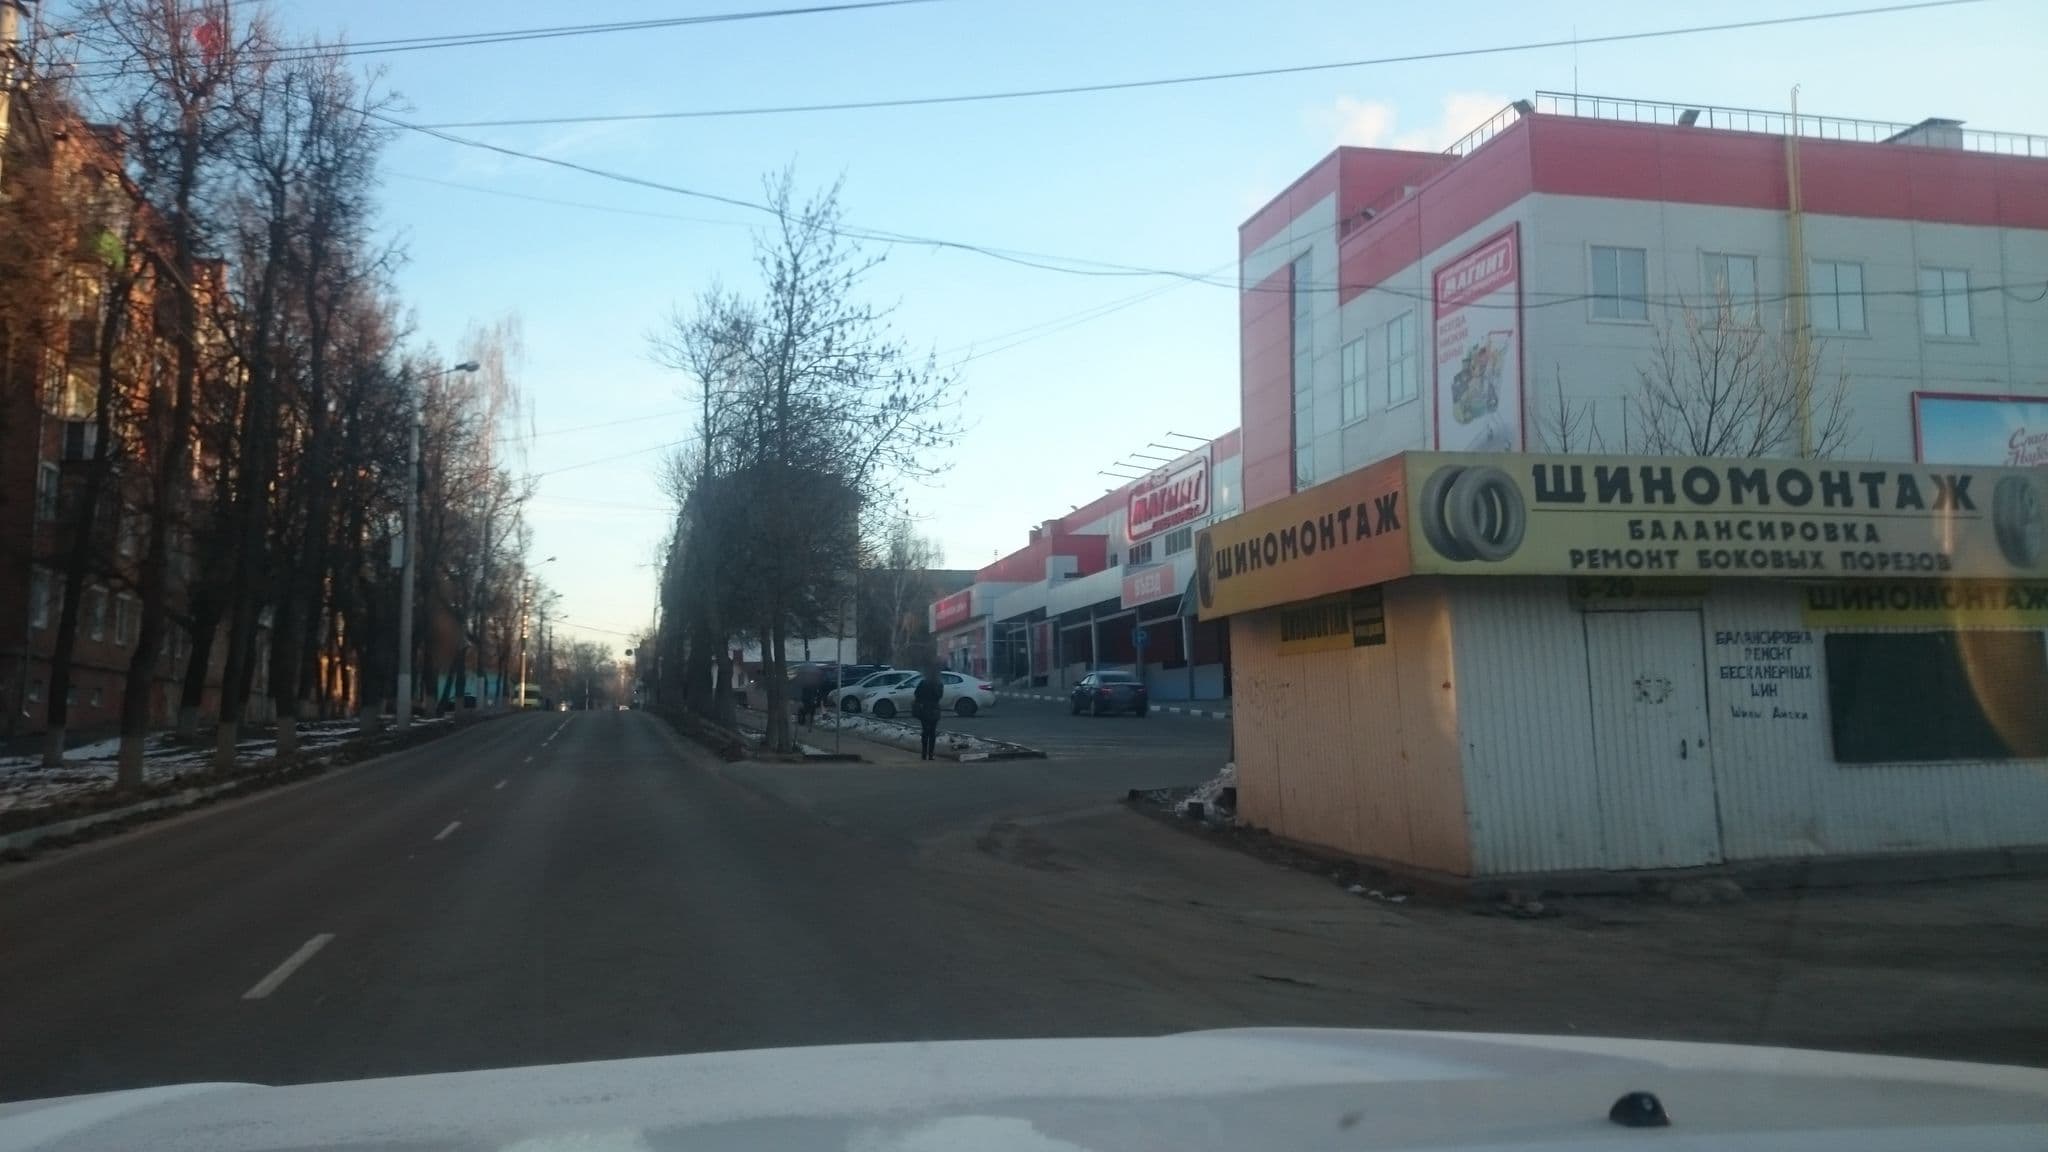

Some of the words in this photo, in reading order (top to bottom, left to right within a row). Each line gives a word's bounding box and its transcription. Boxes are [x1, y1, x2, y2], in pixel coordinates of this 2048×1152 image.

[1443, 248, 1507, 299] МАГНИТ
[1531, 464, 1977, 511] ШИНОМОНТАЖ
[1215, 491, 1401, 580] ШИНОМОНТАЖ
[1628, 519, 1881, 543] БАЛАНСИРОВКА
[1569, 549, 1679, 570] РЕМОНТ
[1697, 549, 1824, 571] БОКОВЫХ
[1841, 551, 1952, 572] ПОРЕЗОВ
[1807, 582, 2048, 611] ШИНОМОНТАЖ
[1715, 631, 1814, 645] БАЛАНСИРОВКА
[1744, 647, 1793, 661] РЕМОНТ
[1719, 665, 1813, 680] БЕСКАМЕРНЫХ
[1751, 683, 1779, 697] ШИН
